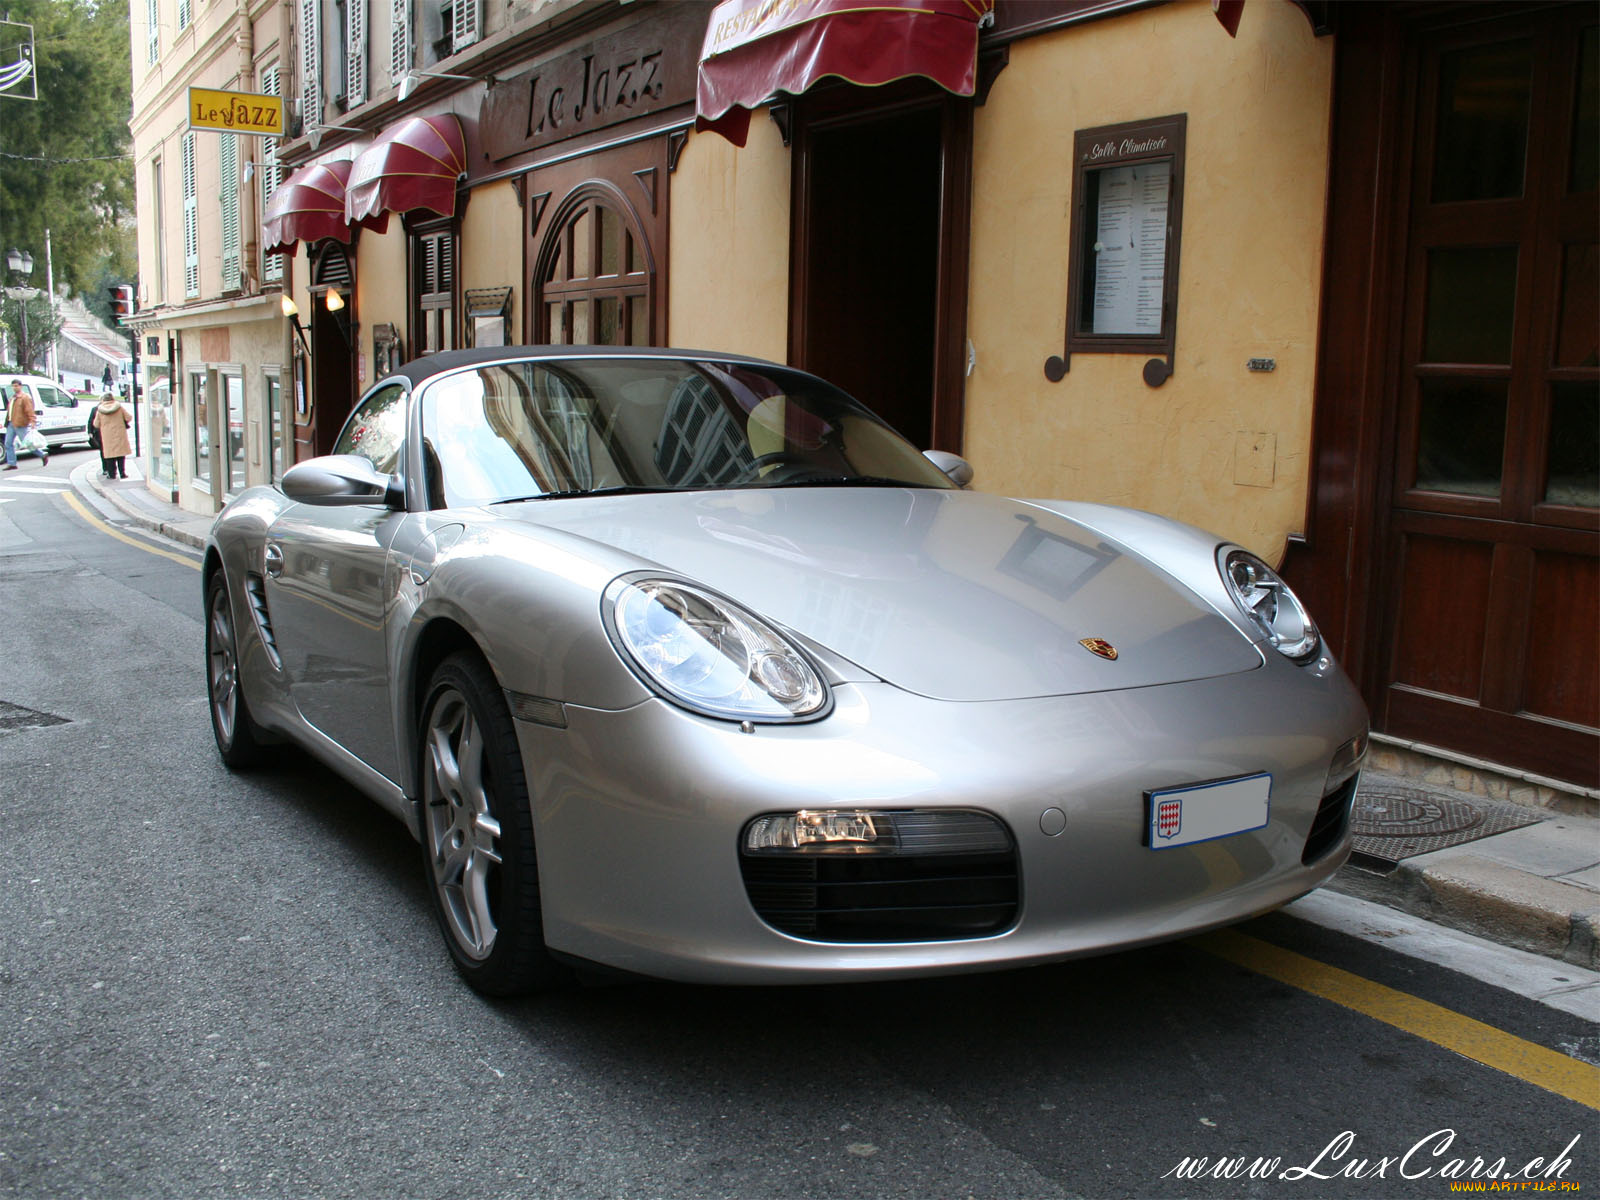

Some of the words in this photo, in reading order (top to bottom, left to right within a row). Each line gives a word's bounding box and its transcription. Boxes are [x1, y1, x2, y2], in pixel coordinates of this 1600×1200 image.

[525, 76, 565, 140] Le
[574, 50, 663, 122] Jazz
[196, 103, 218, 122] Le
[1090, 141, 1116, 160] Salle
[1119, 136, 1167, 156] Climatisée
